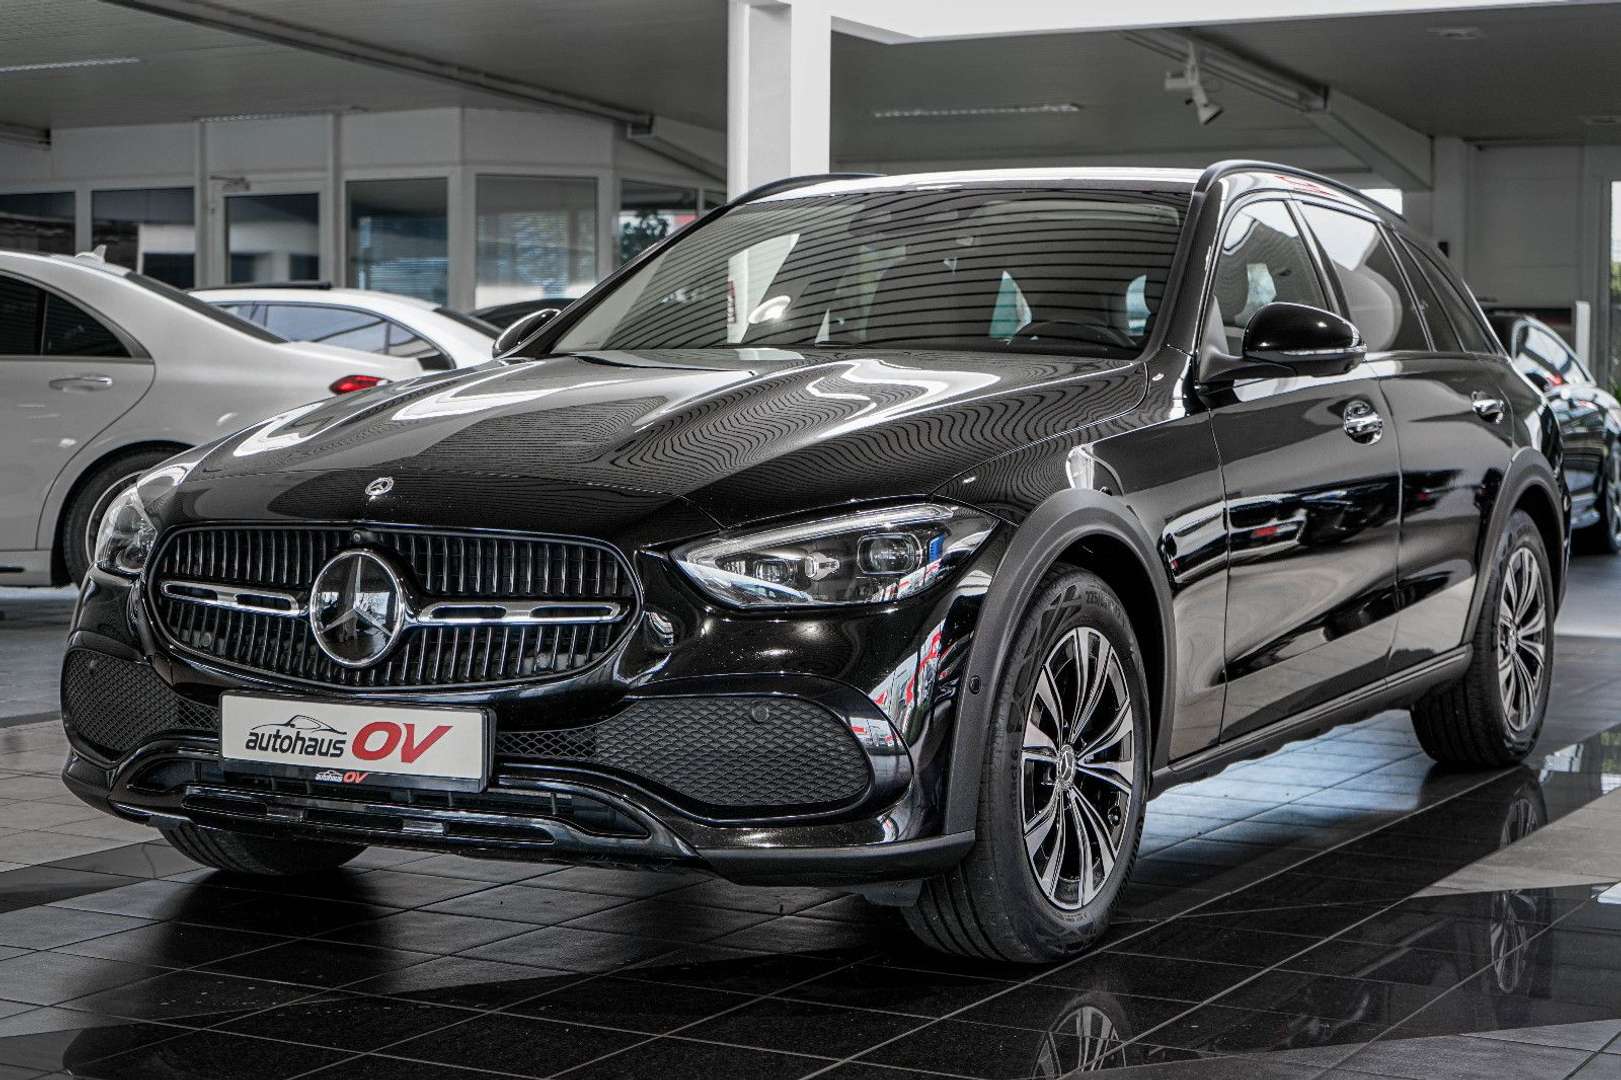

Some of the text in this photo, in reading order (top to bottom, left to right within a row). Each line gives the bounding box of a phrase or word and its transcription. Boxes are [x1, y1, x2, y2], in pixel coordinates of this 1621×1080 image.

[245, 721, 454, 764] autohaus OV
[343, 771, 369, 784] OV
